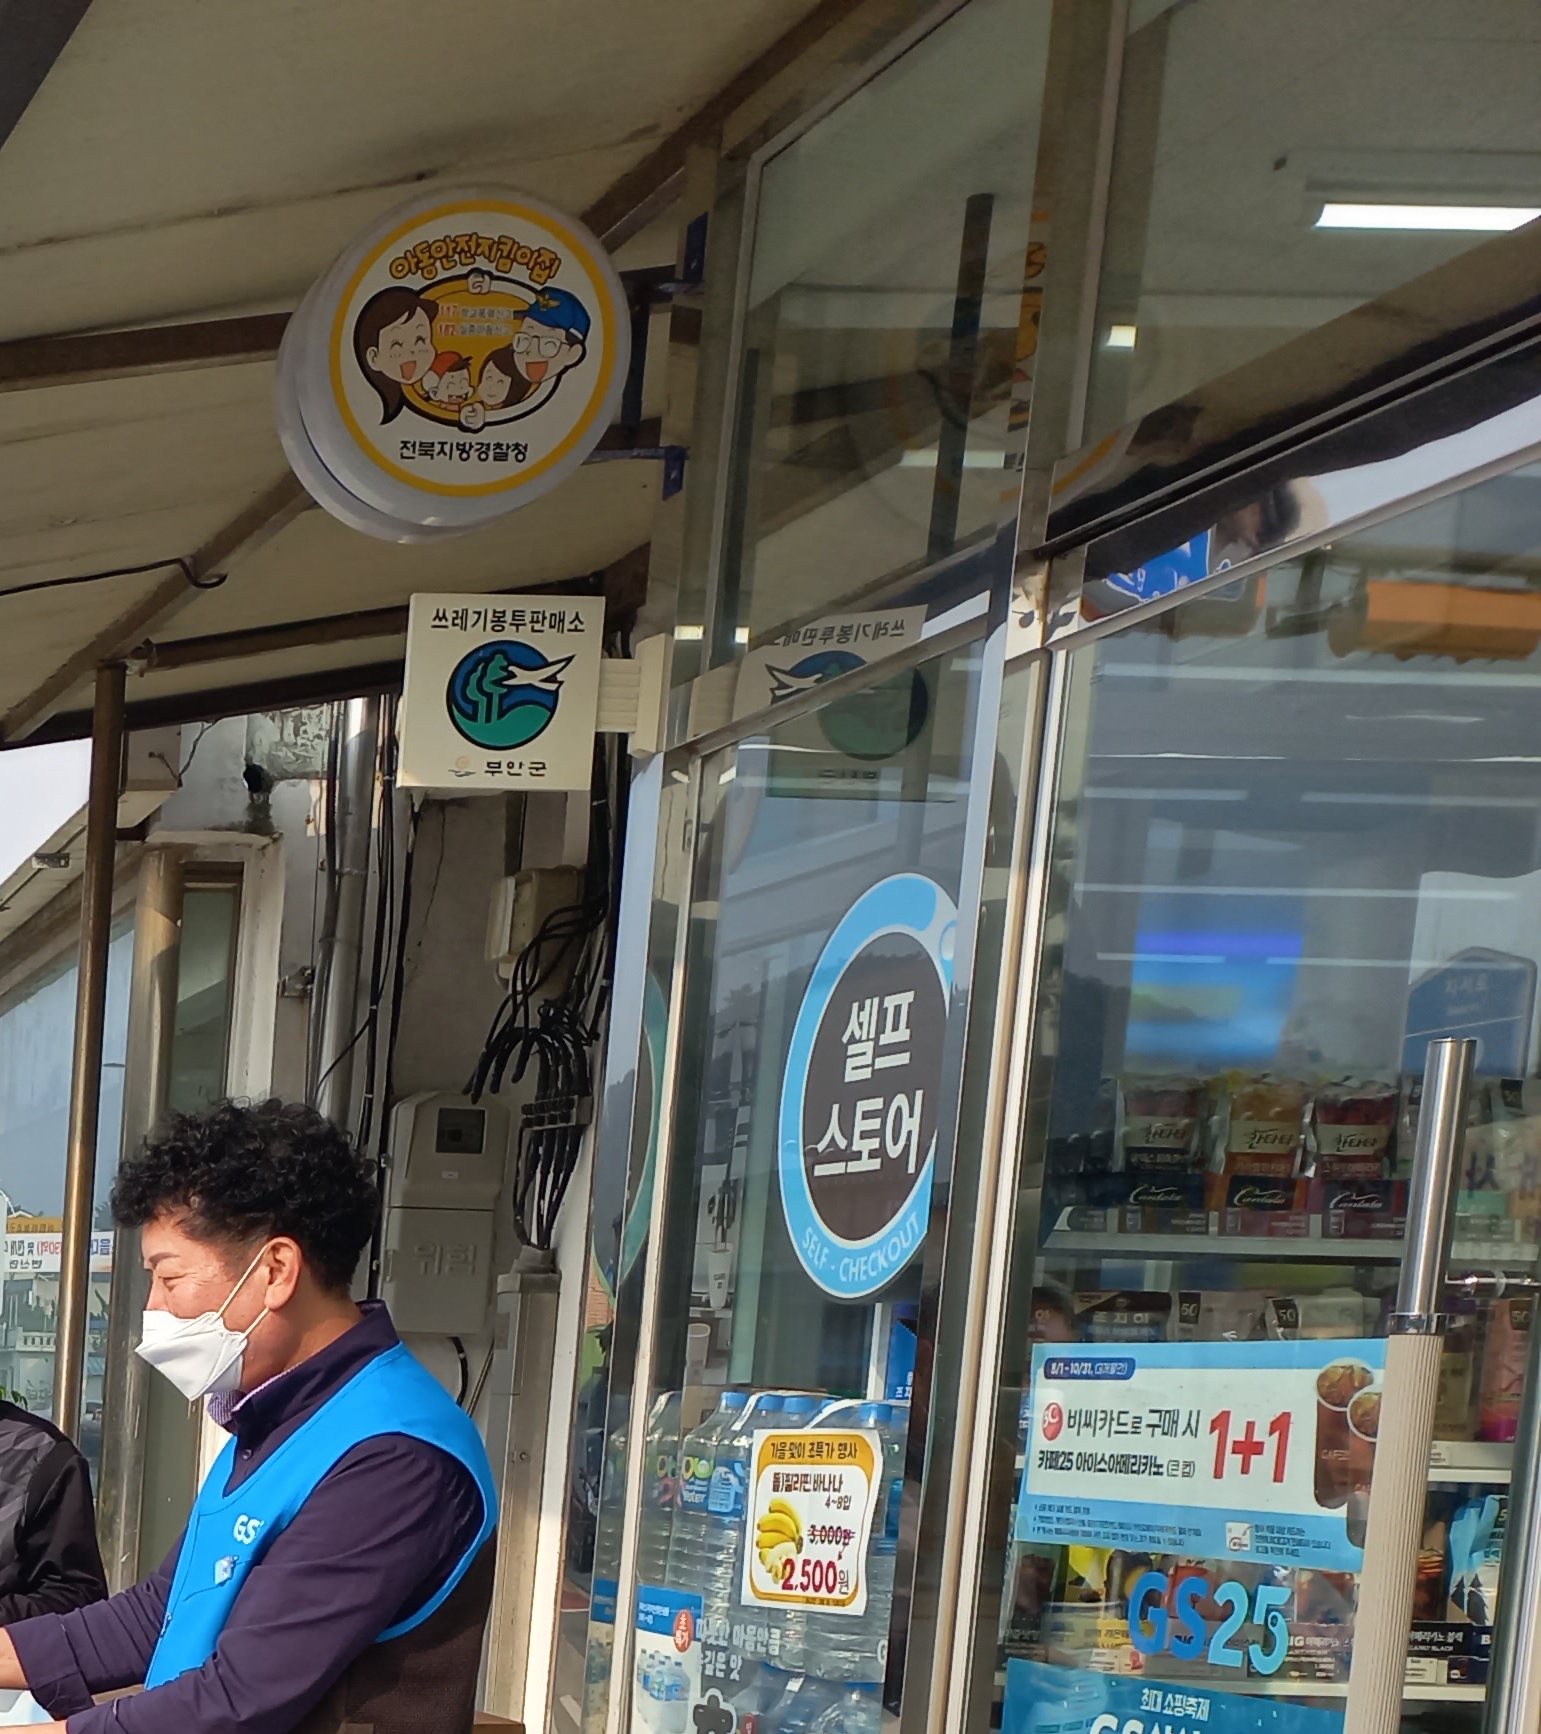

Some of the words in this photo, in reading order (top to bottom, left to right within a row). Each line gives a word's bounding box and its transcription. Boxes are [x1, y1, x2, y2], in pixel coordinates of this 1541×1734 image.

[398, 438, 529, 464] 전북지방경찰청
[430, 608, 587, 635] 쓰레기봉투판매소
[483, 759, 548, 778] 부안군
[841, 990, 916, 1084] 셀프
[813, 1090, 924, 1177] 스토어
[801, 1226, 830, 1271] SELF
[1066, 1408, 1143, 1439] 비씨카드로
[1145, 1408, 1179, 1440] 구매
[1181, 1409, 1202, 1440] 시
[1209, 1410, 1293, 1484] 1+1
[812, 1472, 844, 1494] 바나나
[731, 1622, 781, 1657] 마음만큼
[1127, 1571, 1293, 1676] GS25
[1162, 1692, 1211, 1723] 쇼핑축제
